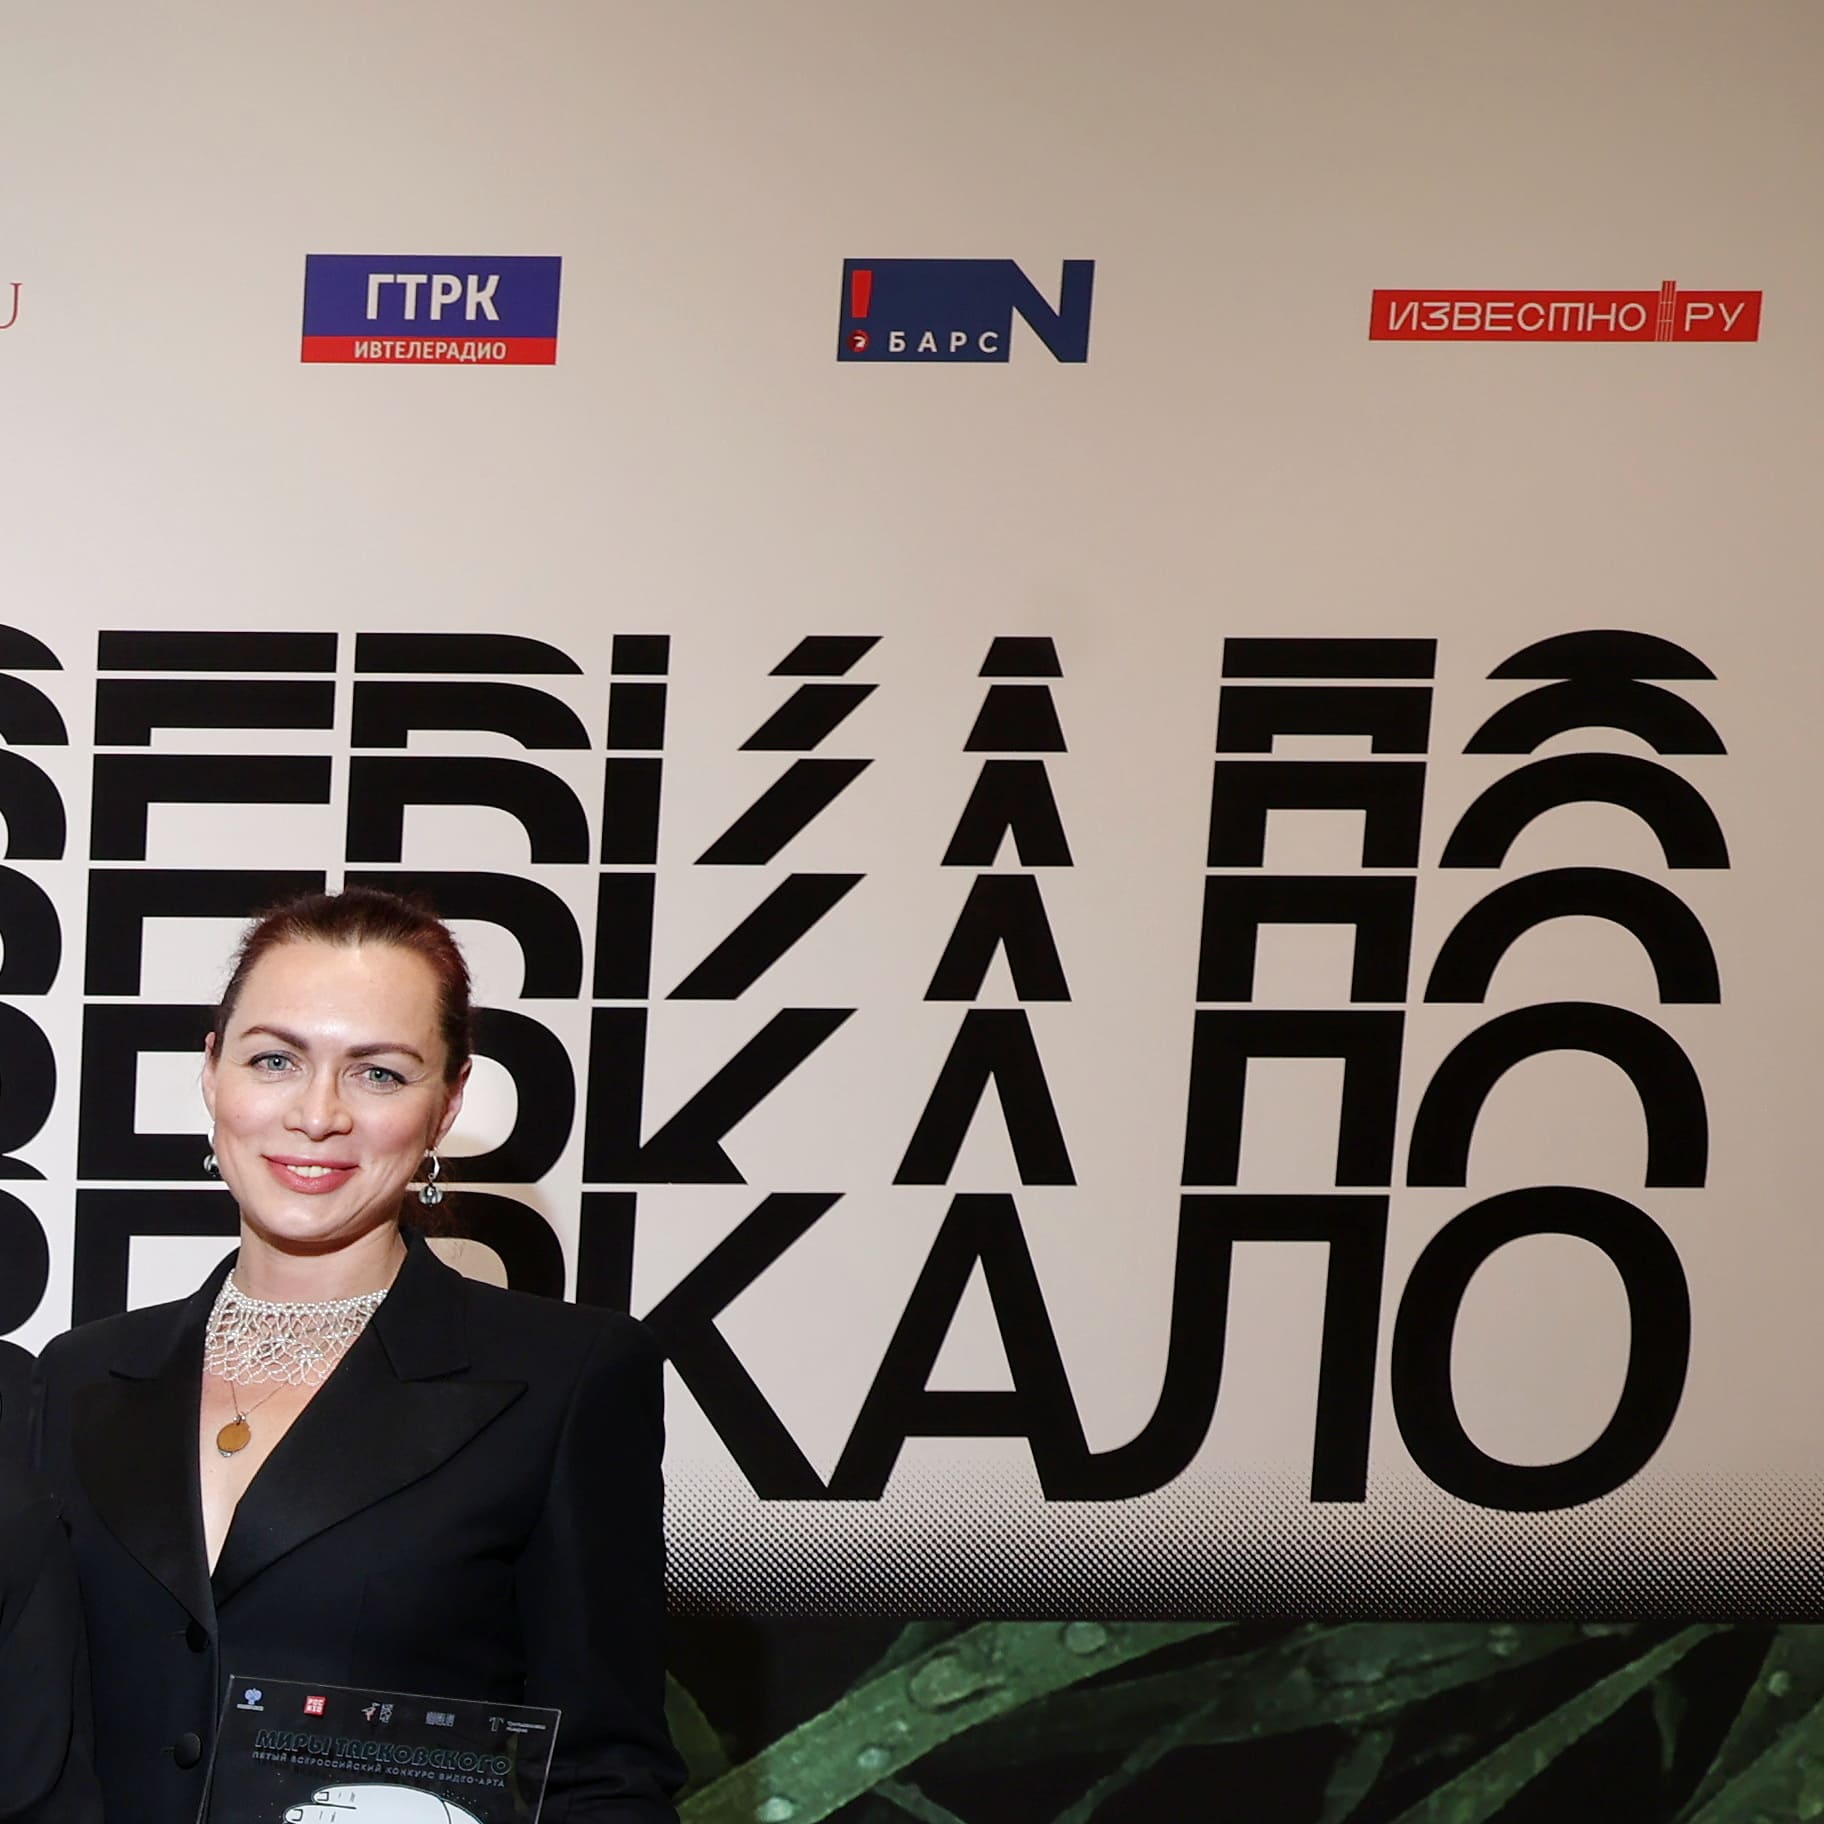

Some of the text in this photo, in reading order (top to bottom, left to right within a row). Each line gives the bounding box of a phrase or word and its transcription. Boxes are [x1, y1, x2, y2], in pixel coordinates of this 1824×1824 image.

[365, 273, 501, 324] ГТРК
[1684, 302, 1745, 332] РУ
[353, 339, 509, 362] ИВТЕЛЕРАДИО
[888, 331, 999, 353] БАРС
[254, 1730, 512, 1776] МИРЫ ТАРКОВСКОГО
